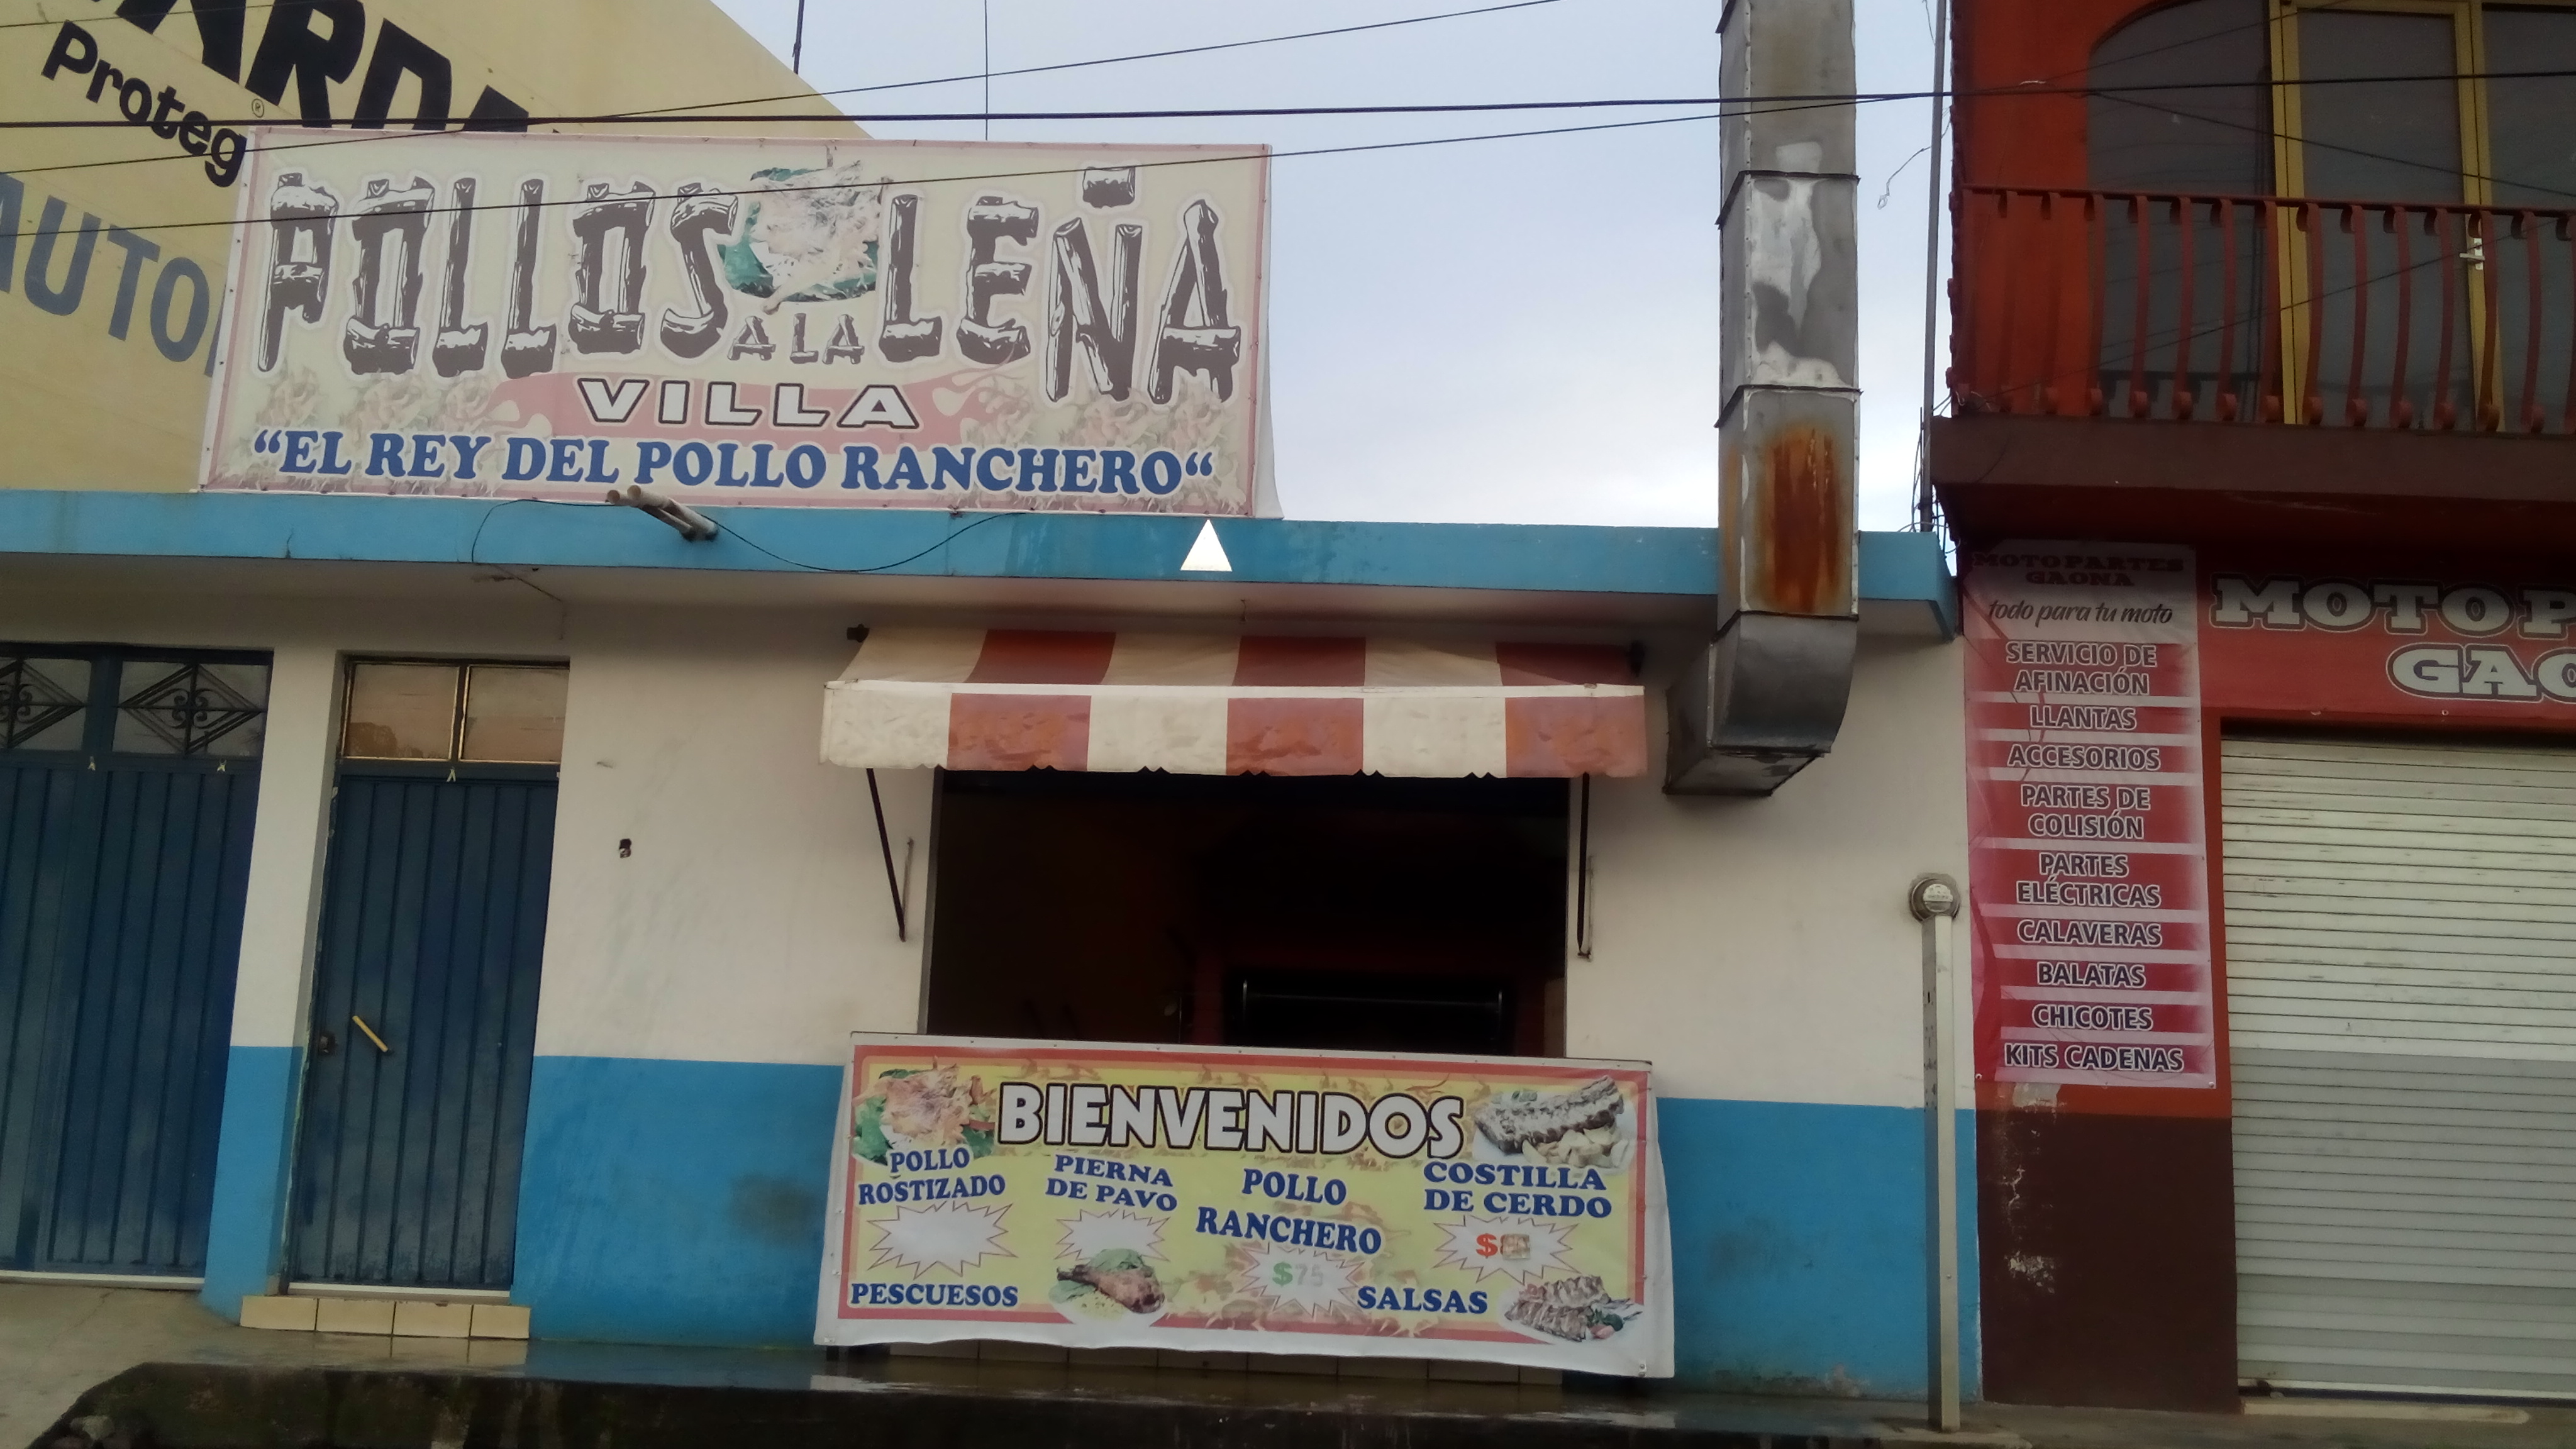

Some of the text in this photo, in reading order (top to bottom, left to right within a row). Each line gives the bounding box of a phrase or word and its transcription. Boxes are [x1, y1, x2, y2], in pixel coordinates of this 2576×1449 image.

[256, 165, 1241, 404] POLLOS A LA LEÑA
[576, 377, 921, 430] VILLA
[365, 432, 492, 480] REY
[502, 436, 620, 484] DEL
[634, 440, 826, 489] POLLO
[2025, 570, 2135, 587] GAONA
[1989, 599, 2173, 628] todo para tu moto
[2006, 641, 2157, 667] SERVICIO DE
[2014, 667, 2150, 696] AFINACIÓN
[2030, 705, 2136, 730] LLANTAS
[2007, 744, 2161, 770] ACCESORIOS
[2021, 784, 2150, 810] PARTES DE
[2028, 809, 2144, 839] COLISIÓN
[2039, 853, 2129, 878] PARTES
[2016, 873, 2161, 908] ELÉCTRICAS
[2017, 919, 2163, 947] CALAVERAS
[2037, 962, 2146, 989] BALATAS
[2032, 1004, 2153, 1031] CHICOTES
[2004, 1043, 2184, 1072] KITS CADENAS
[997, 1081, 1464, 1160] BIENVENIDOS
[890, 1147, 970, 1173] POLLO
[1054, 1153, 1174, 1187] PIERNA
[858, 1174, 1006, 1206] ROSTIZADO
[1241, 1168, 1347, 1206] POLLO
[1423, 1161, 1607, 1191] COSTILLA
[1045, 1177, 1178, 1212] DE PAVO
[1423, 1188, 1613, 1219] DE CERDO
[1196, 1206, 1382, 1255] RANCHERO
[851, 1282, 1019, 1307] PESCUESOS
[1357, 1284, 1488, 1314] SALSAS
